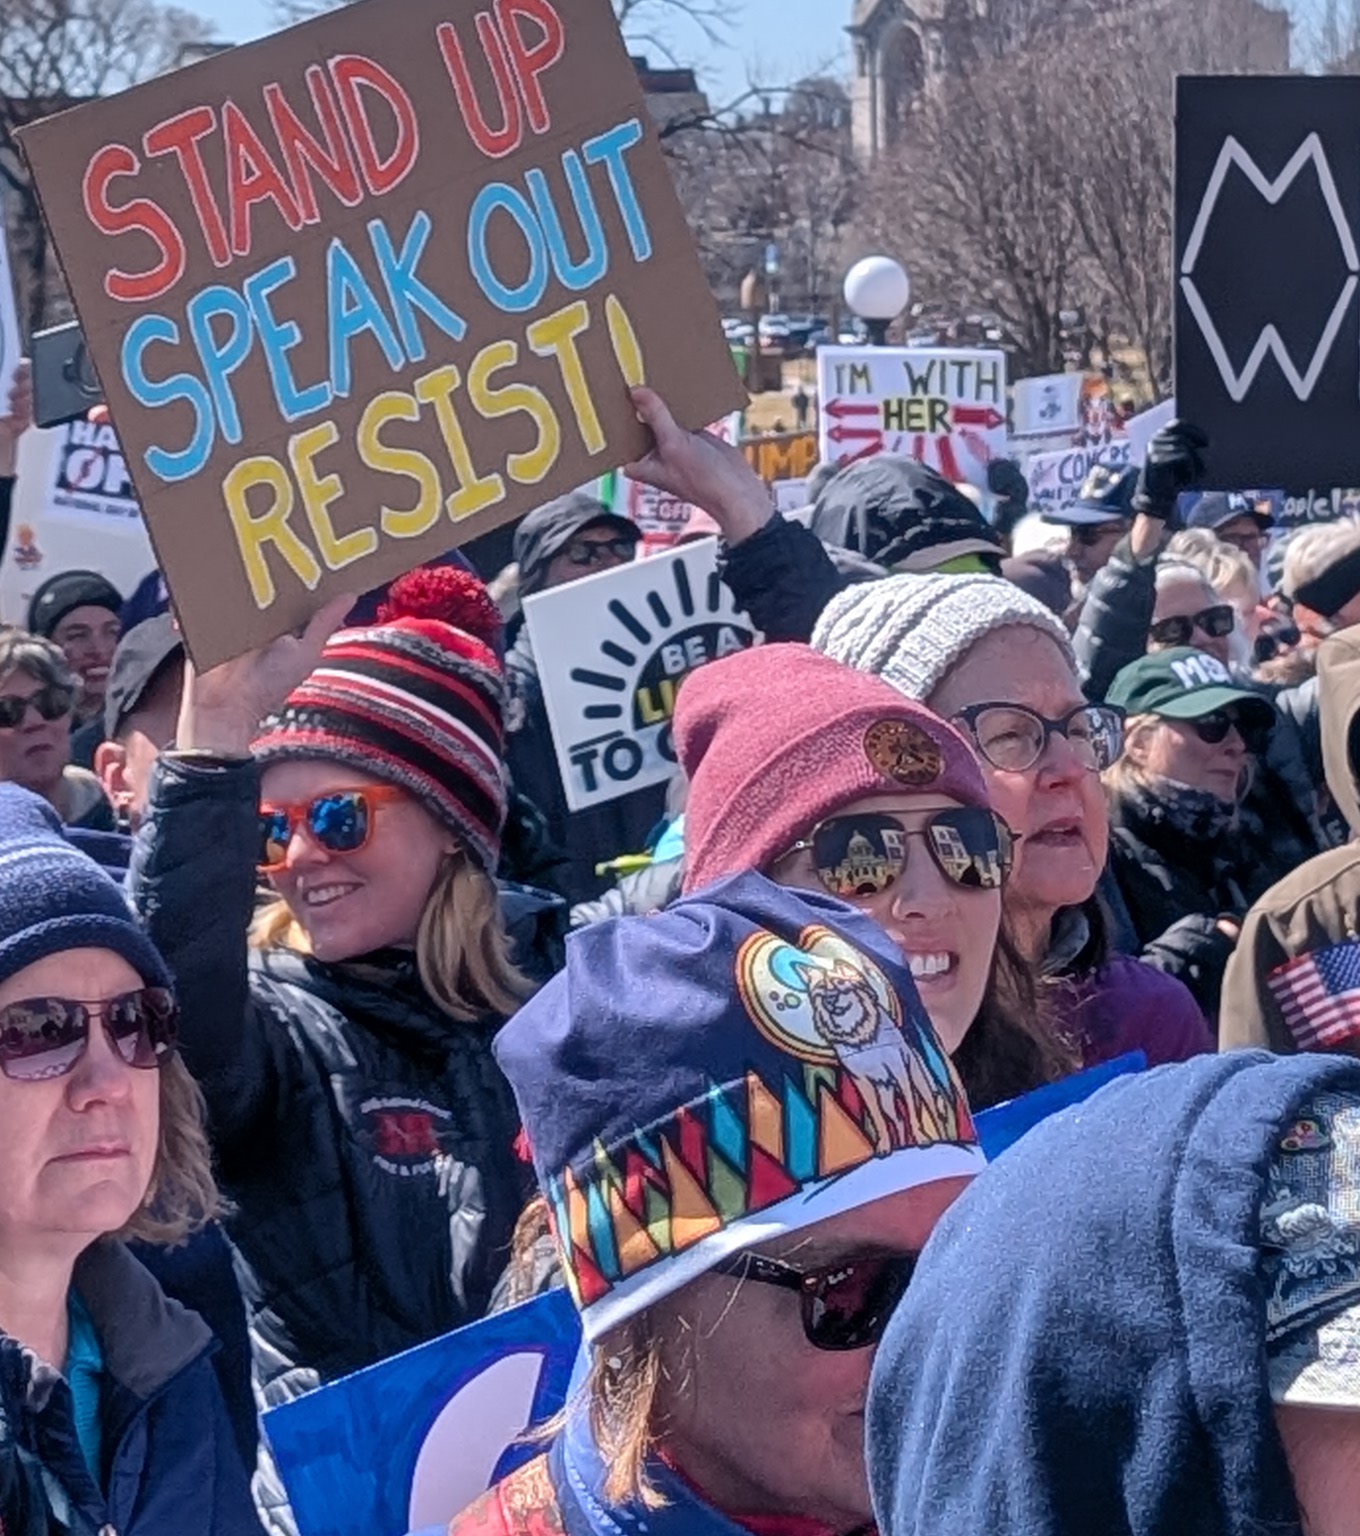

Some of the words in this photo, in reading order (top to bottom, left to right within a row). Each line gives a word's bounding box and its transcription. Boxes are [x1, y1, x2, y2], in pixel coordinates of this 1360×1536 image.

[83, 54, 419, 302] STAND
[121, 210, 467, 481] SPEAK
[467, 119, 653, 312] OUT
[903, 359, 999, 404] WITH
[882, 398, 952, 434] HER
[222, 294, 645, 609] RESIST!
[661, 635, 708, 676] BE
[569, 737, 644, 792] TO
